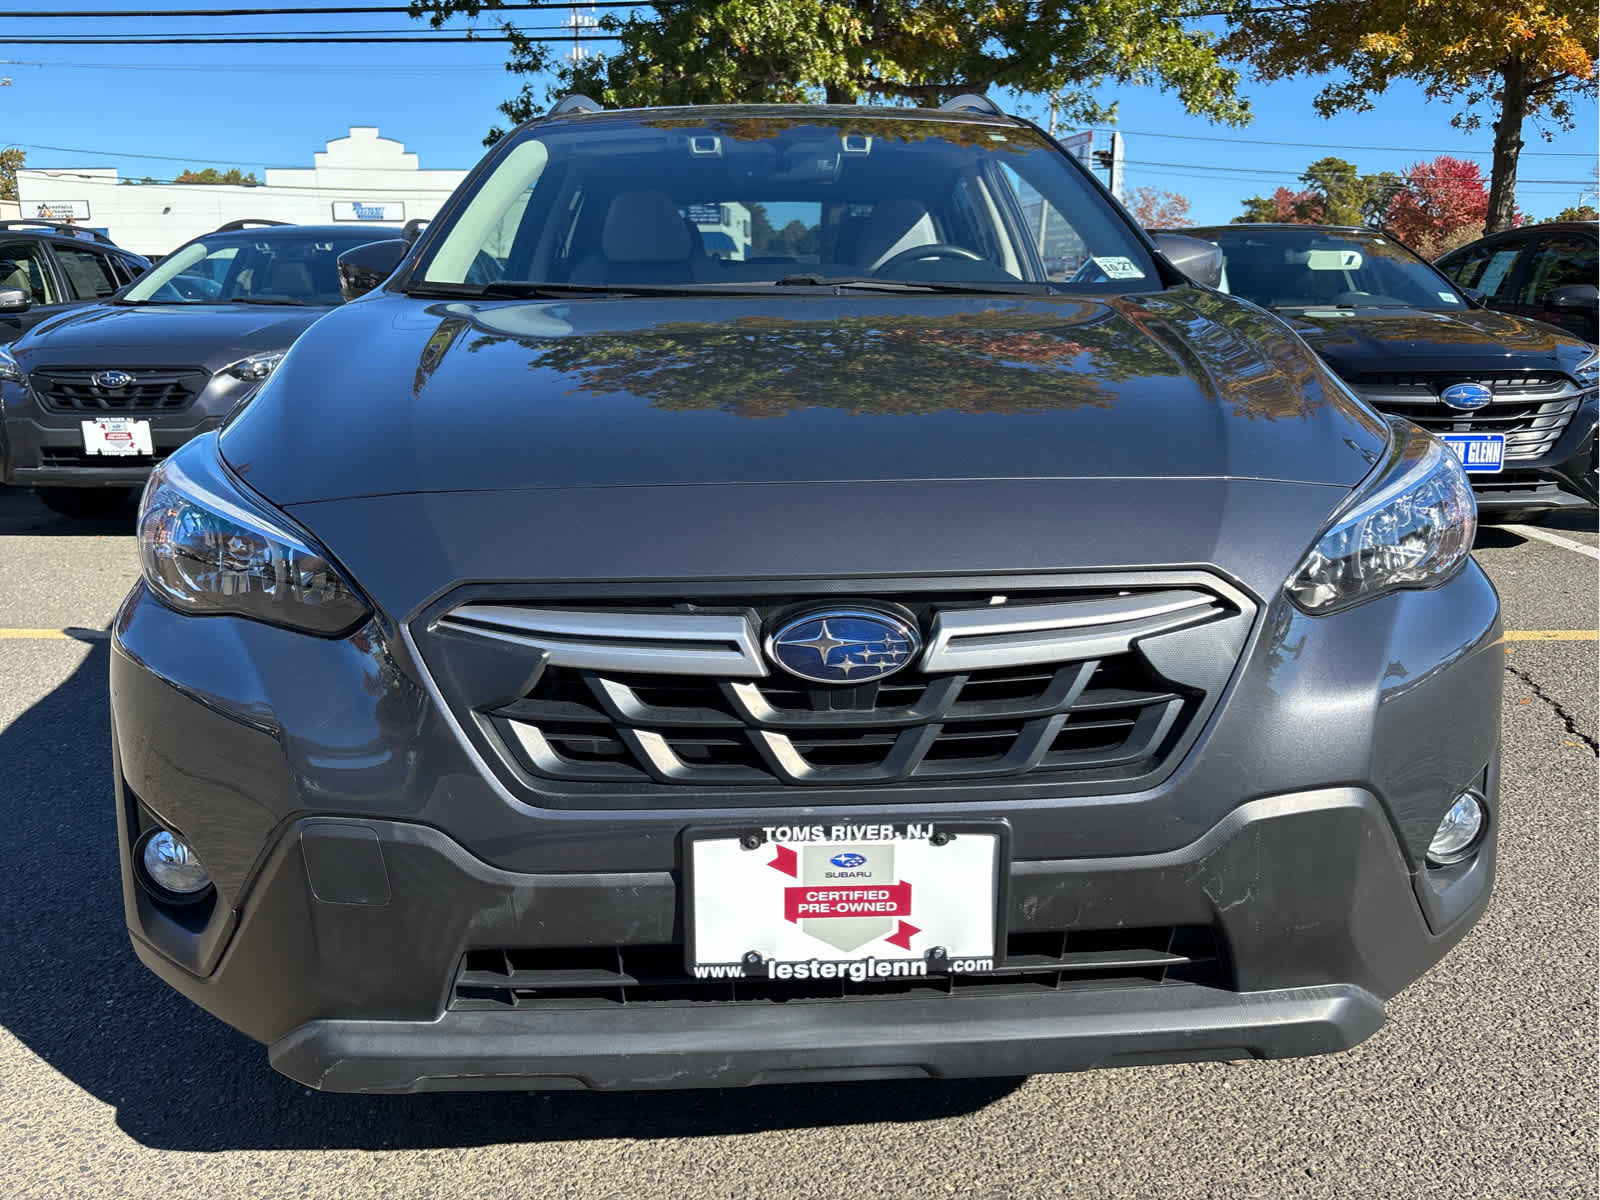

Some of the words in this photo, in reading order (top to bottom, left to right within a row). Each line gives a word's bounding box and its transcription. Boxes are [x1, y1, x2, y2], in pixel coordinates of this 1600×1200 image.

[1468, 442, 1501, 463] GLENN
[762, 826, 824, 841] TOMS
[907, 823, 934, 838] NJ
[824, 871, 872, 879] SUBARU
[806, 890, 890, 902] CERTIFIED
[798, 902, 898, 914] PRE-OWNED
[694, 964, 747, 979] www.
[768, 958, 928, 982] lesterglenn
[947, 957, 994, 973] .com
